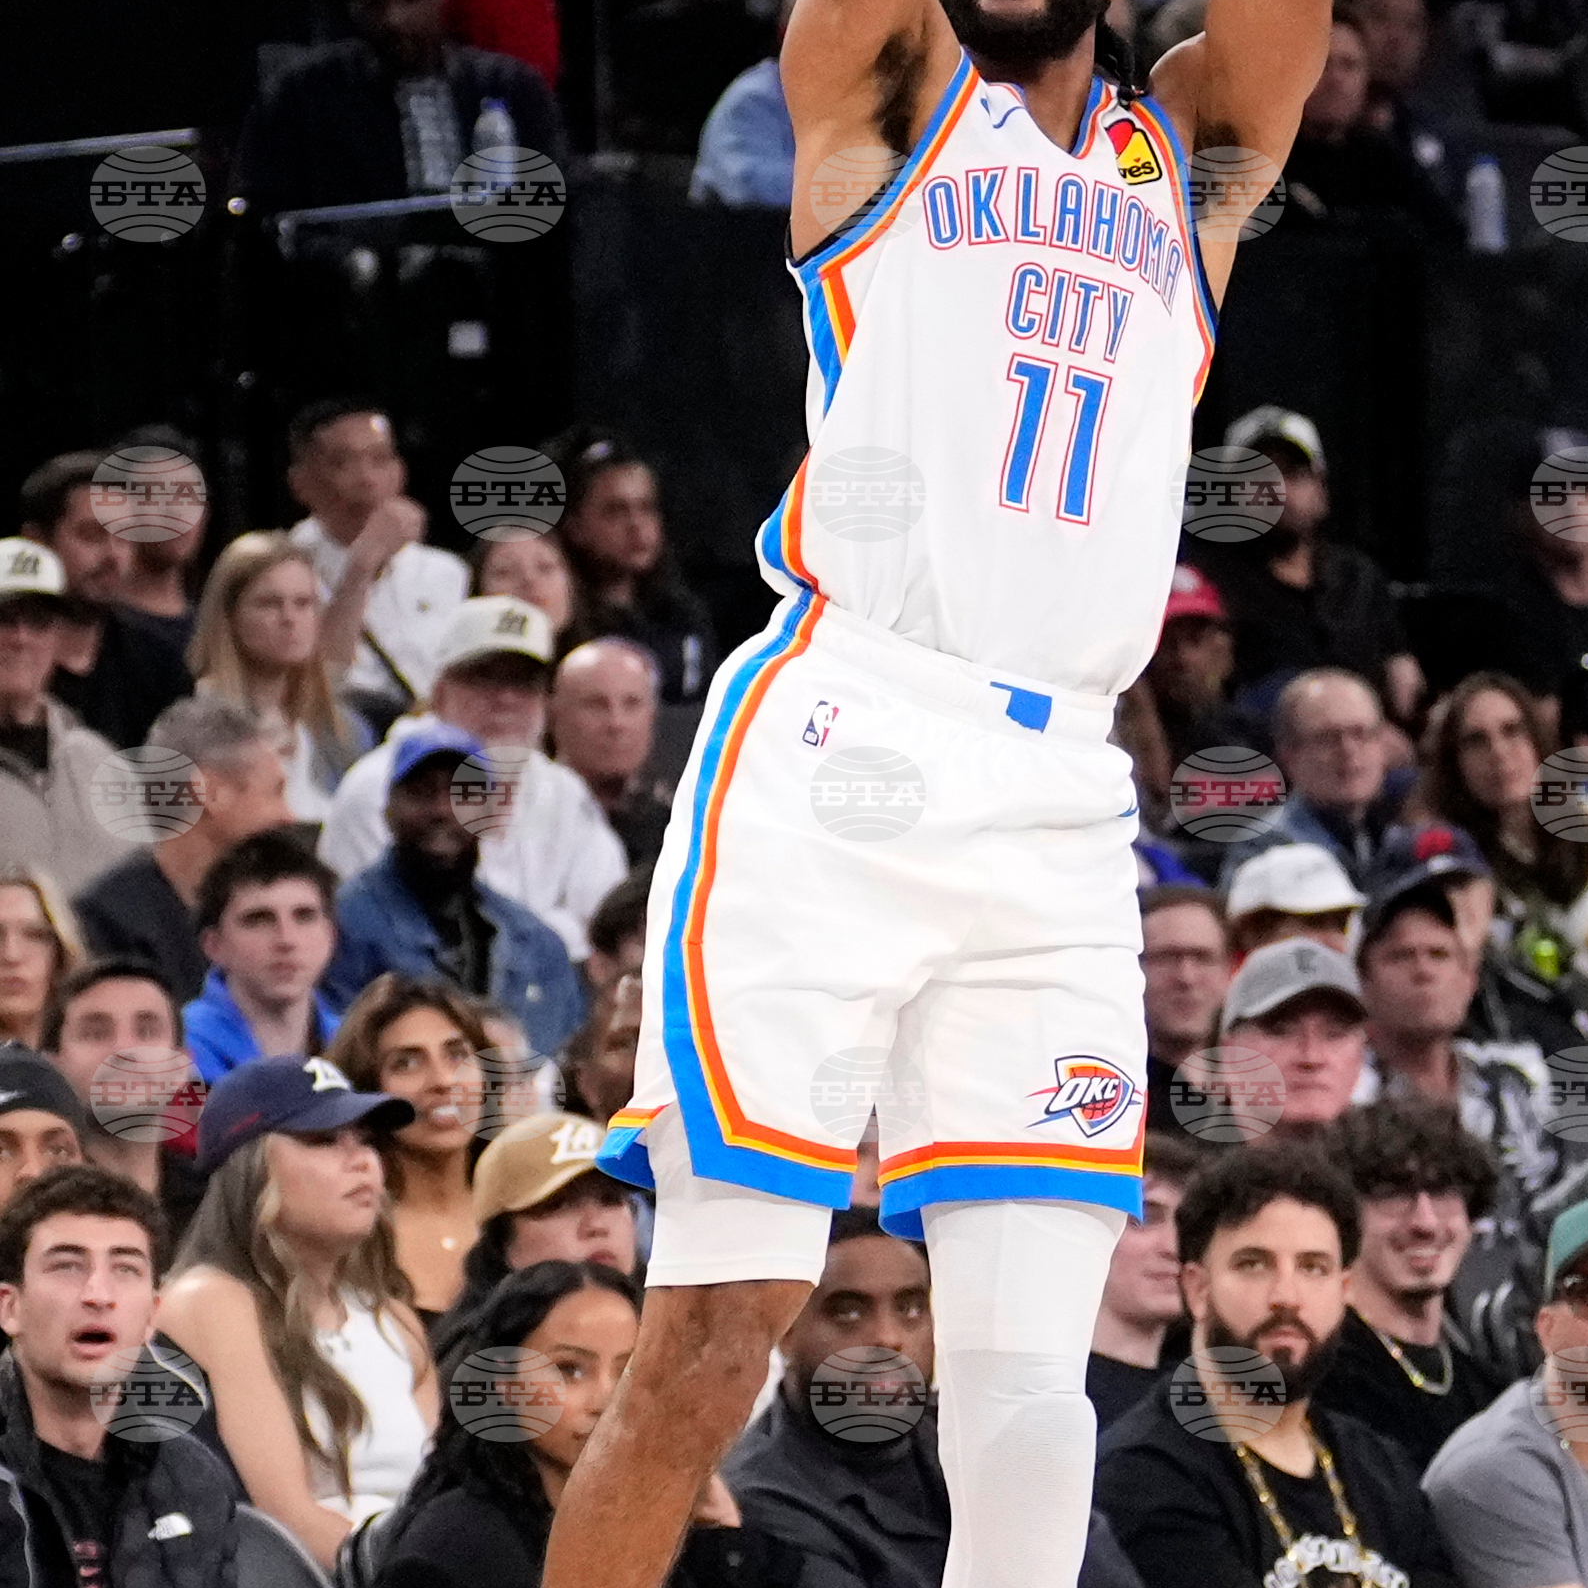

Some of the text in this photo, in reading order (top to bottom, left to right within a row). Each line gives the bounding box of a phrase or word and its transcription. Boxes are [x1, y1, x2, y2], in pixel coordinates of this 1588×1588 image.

[923, 165, 1184, 317] OKLAHOMA
[1005, 262, 1134, 363] CITY
[999, 352, 1112, 526] 11
[1045, 1077, 1120, 1115] OKC
